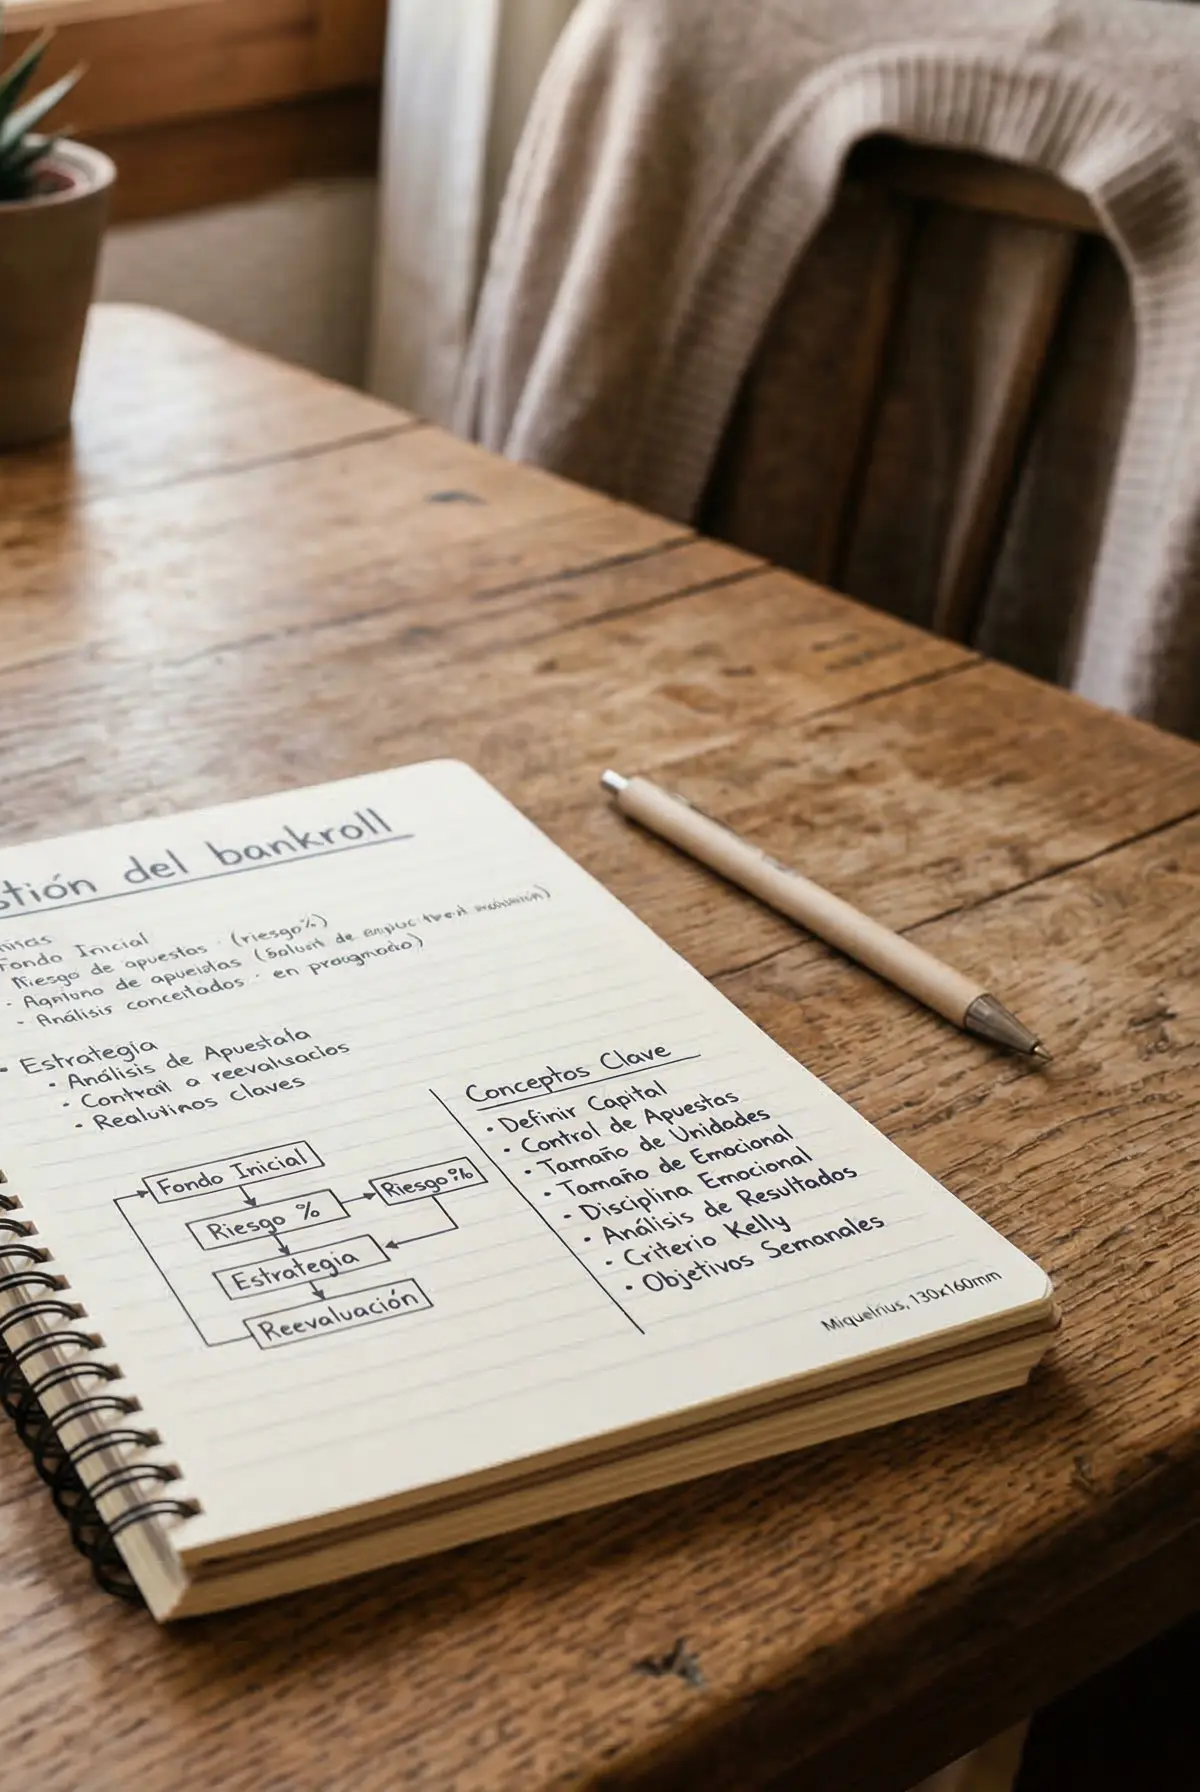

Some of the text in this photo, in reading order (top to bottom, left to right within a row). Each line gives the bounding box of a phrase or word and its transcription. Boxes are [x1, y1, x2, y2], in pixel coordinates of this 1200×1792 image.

[123, 849, 189, 884] del
[204, 808, 393, 866] bankroll
[75, 931, 149, 958] Inicial
[91, 962, 115, 976] de
[125, 945, 208, 971] apuestas
[36, 1003, 113, 1028] Análisis
[273, 966, 300, 979] en
[115, 977, 142, 991] de
[19, 1040, 159, 1074] Estrategia
[68, 1063, 156, 1089] Análisis
[166, 1052, 194, 1069] de
[185, 1077, 201, 1088] a
[465, 1045, 672, 1102] Conceptos Clave
[497, 1079, 668, 1133] Definir Capital
[520, 1091, 740, 1153] Control de Apuestas
[536, 1107, 771, 1176] Tamaño de Unidades
[555, 1124, 794, 1198] Tamaño de Emocional
[156, 1147, 308, 1195] Fondo Inicial
[578, 1146, 814, 1221] Disciplina Emocional
[206, 1201, 320, 1240] Riesgo %
[602, 1165, 858, 1245] Análisis de Resultados
[623, 1212, 792, 1267] Criterio Kelly
[642, 1214, 886, 1293] Objetivos Semanales
[230, 1251, 360, 1291] Estrategia
[908, 1269, 1003, 1306] 130x160mm
[257, 1289, 420, 1342] Reevaluación
